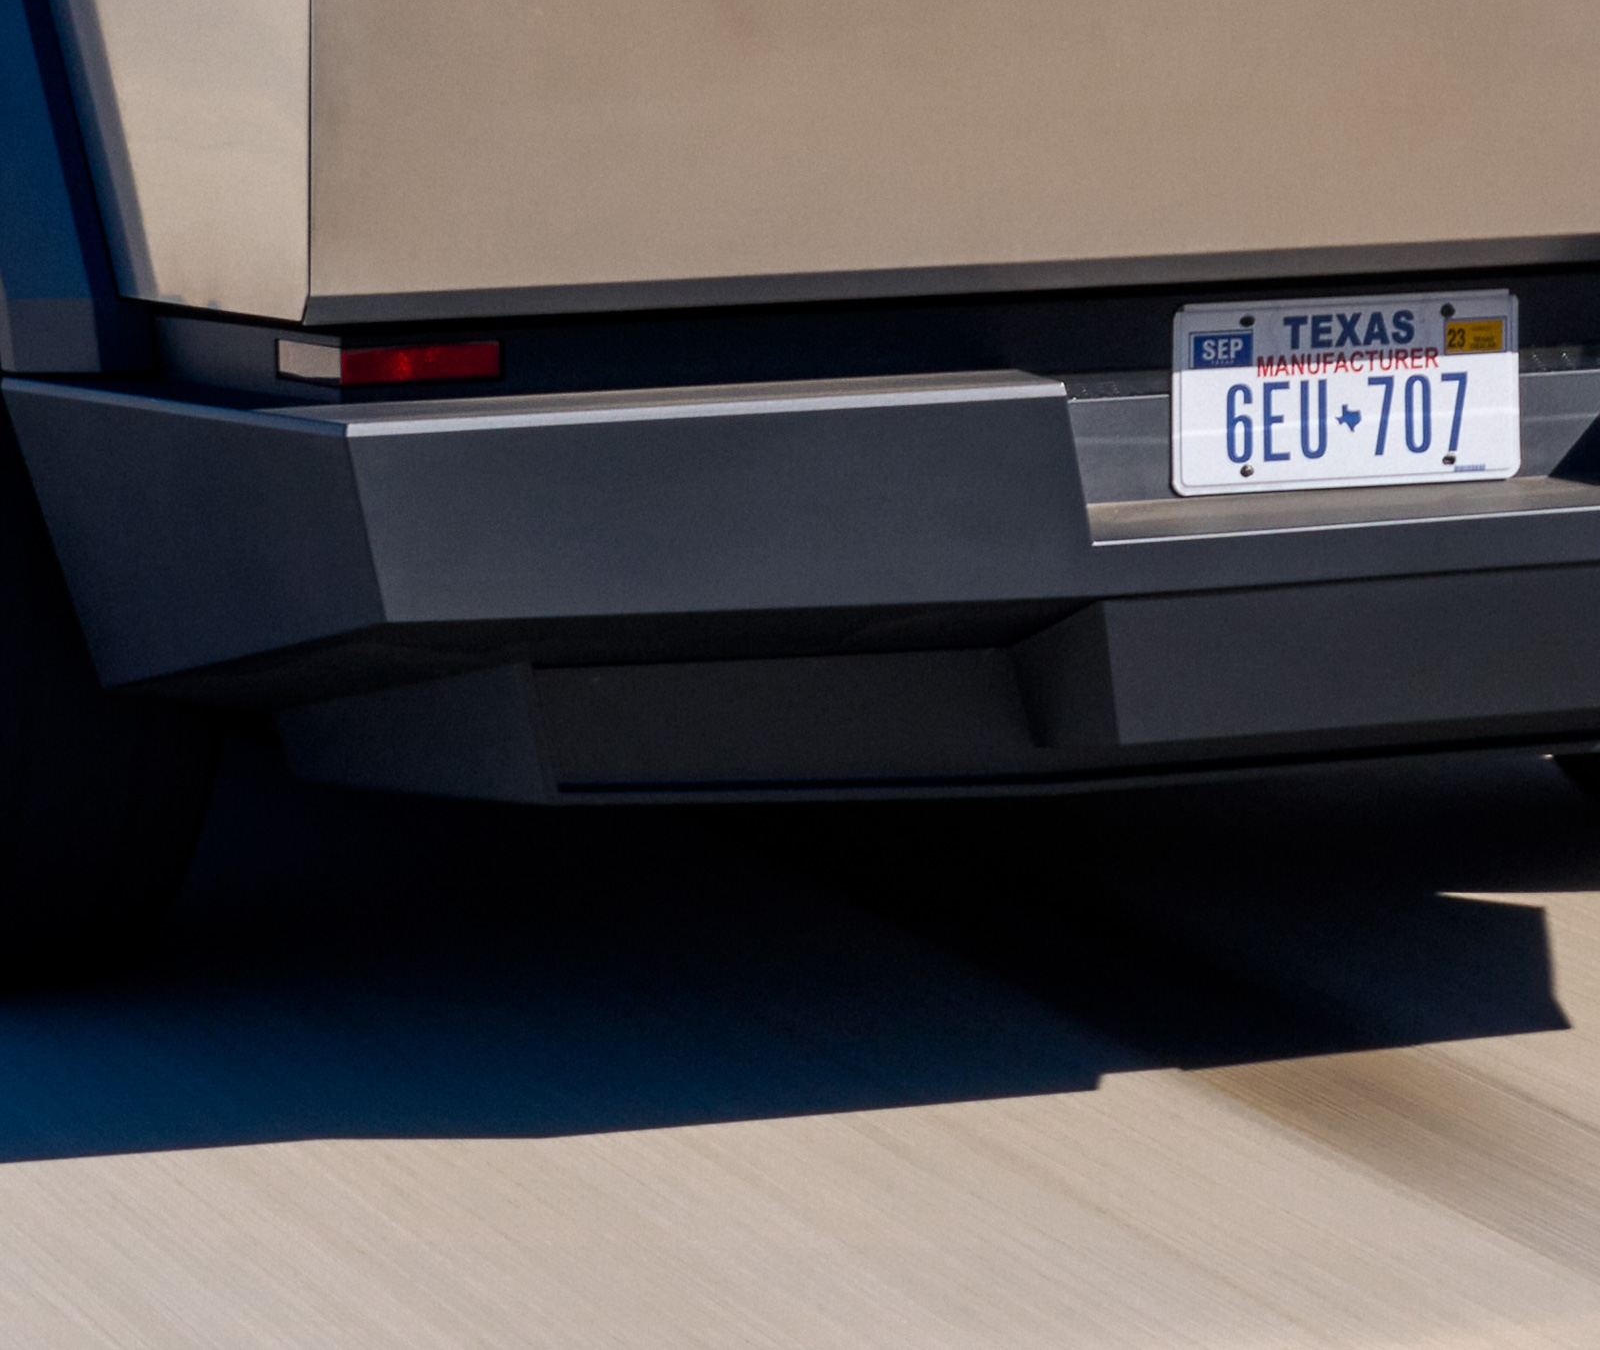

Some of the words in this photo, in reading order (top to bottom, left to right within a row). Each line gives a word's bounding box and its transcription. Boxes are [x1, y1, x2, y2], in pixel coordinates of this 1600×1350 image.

[1283, 309, 1415, 349] TEXAS
[1447, 327, 1466, 348] 23
[1202, 338, 1244, 360] SEP
[1256, 347, 1439, 377] MANUFACTURER
[1226, 378, 1328, 464] 6EU
[1367, 371, 1468, 456] 707
